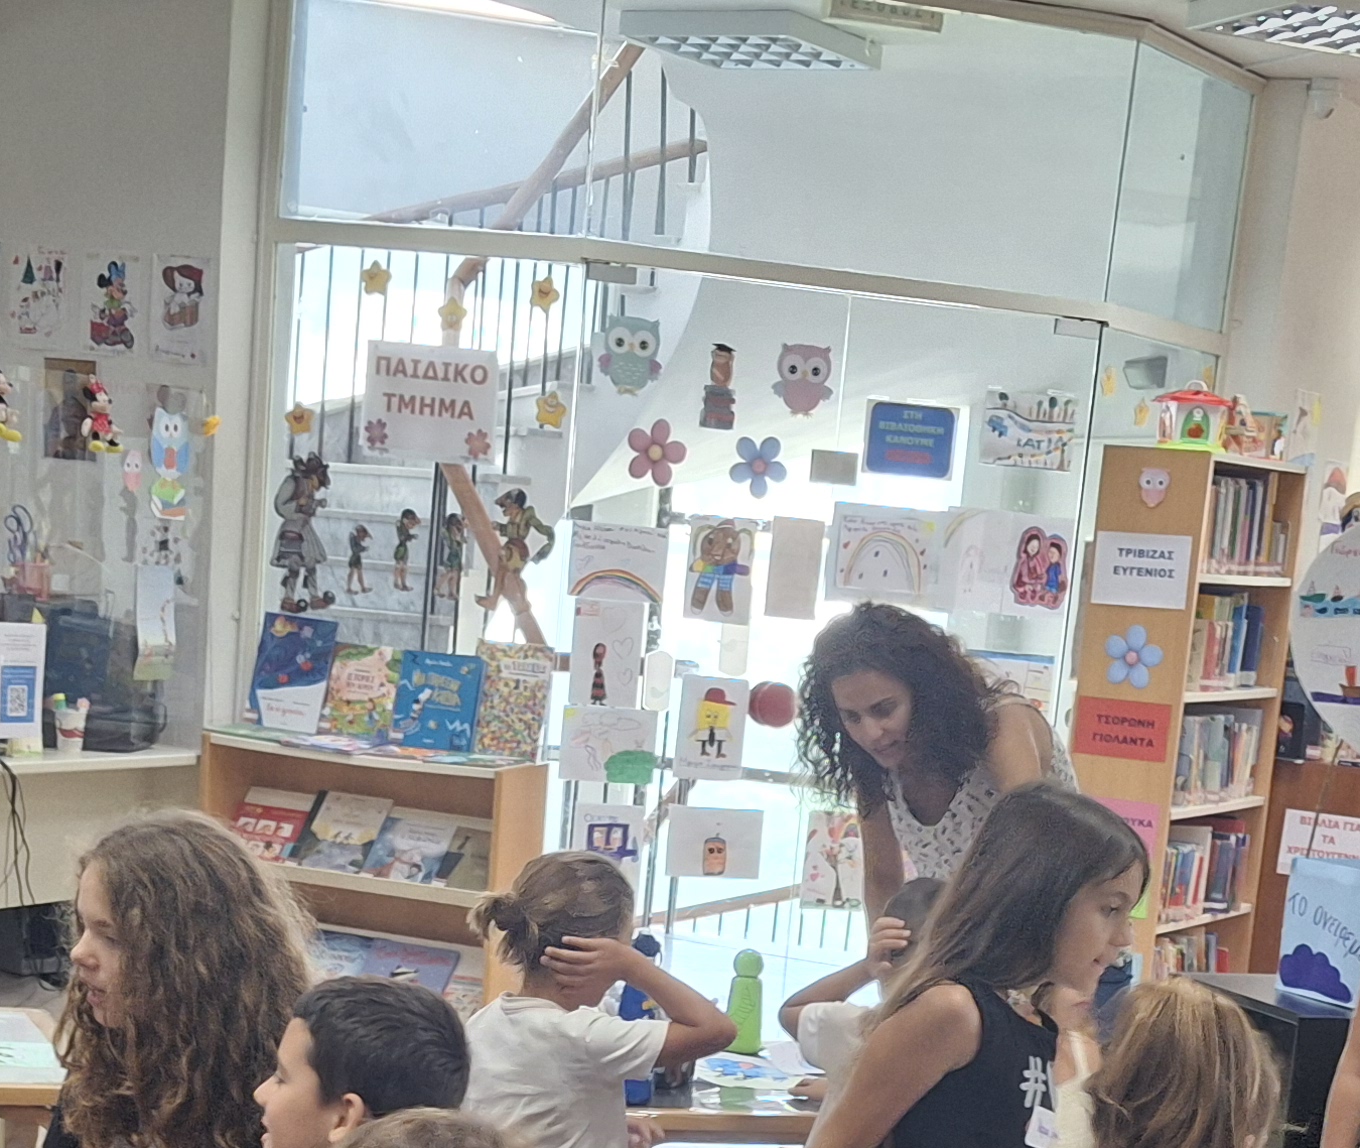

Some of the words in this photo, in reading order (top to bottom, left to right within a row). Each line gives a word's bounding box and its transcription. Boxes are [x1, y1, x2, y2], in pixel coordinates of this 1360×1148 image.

[375, 356, 489, 386] ΠΑΙΔΙΚΟ
[382, 392, 475, 421] ΤΜΗΜΑ
[1117, 547, 1175, 561] ΤΡΙΒΙΖΑΣ
[1112, 565, 1176, 579] ΕΥΓΕΝΙΟΣ
[1096, 714, 1156, 729] ΤΣΟΡΩΝΗ
[1092, 732, 1155, 748] ΓΙΟΛΑΝΤΑ
[1124, 817, 1154, 829] ΟΥΚΑ
[1321, 834, 1336, 846] ΤΑ
